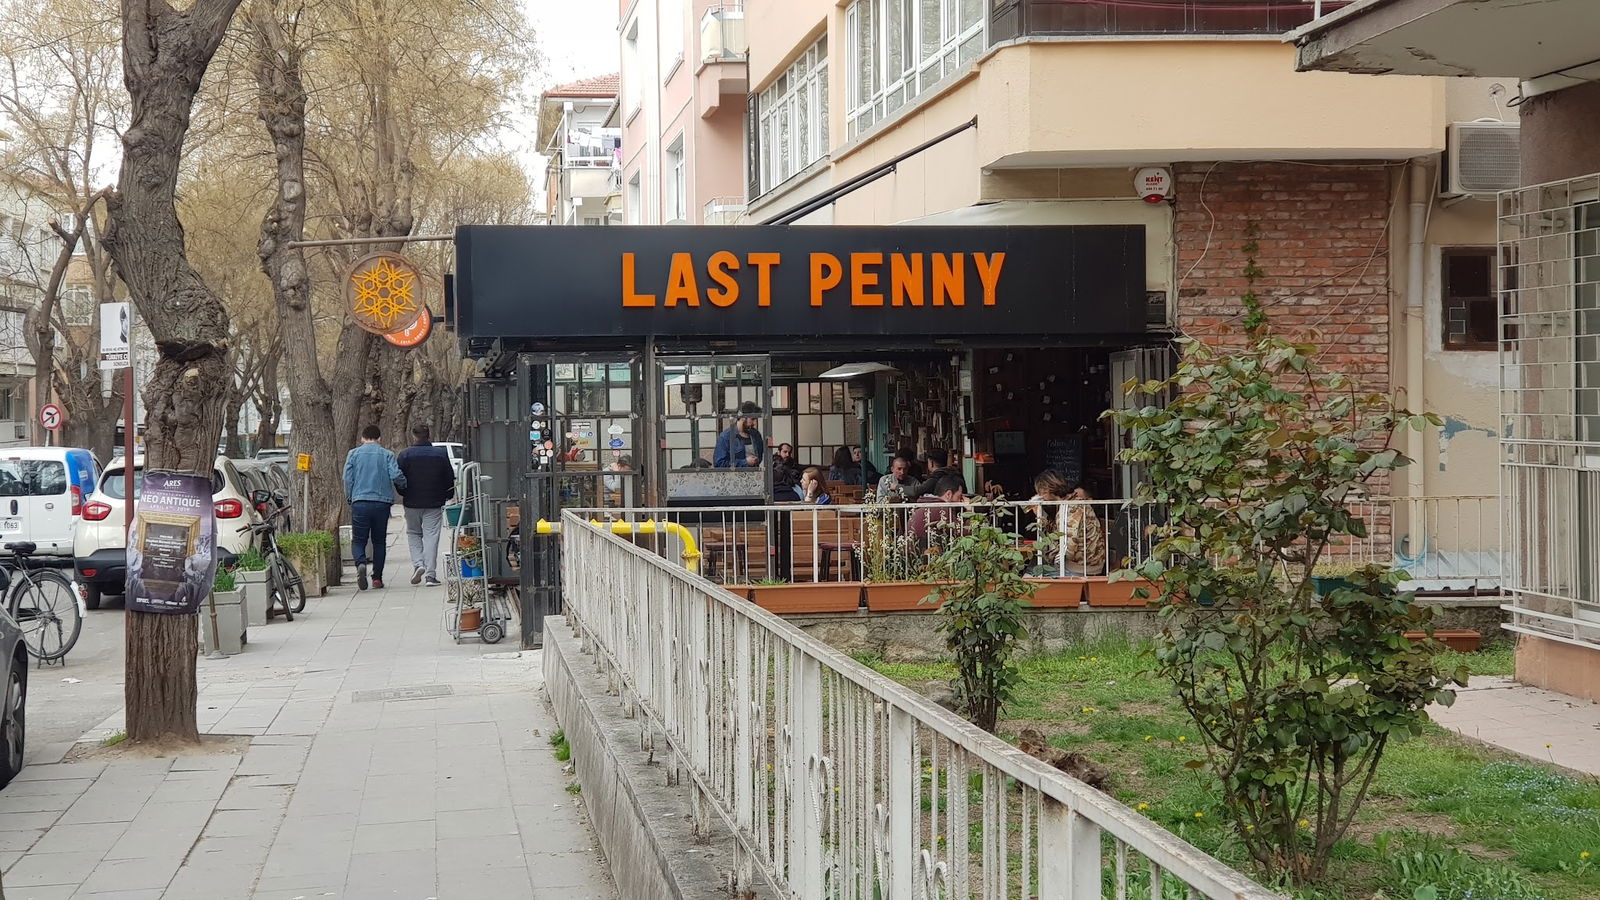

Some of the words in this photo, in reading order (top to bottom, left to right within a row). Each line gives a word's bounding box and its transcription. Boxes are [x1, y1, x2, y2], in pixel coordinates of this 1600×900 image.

[622, 251, 781, 307] LAST
[809, 252, 1006, 306] PENNY
[140, 494, 158, 503] NEO
[160, 496, 200, 508] ANTIQUE
